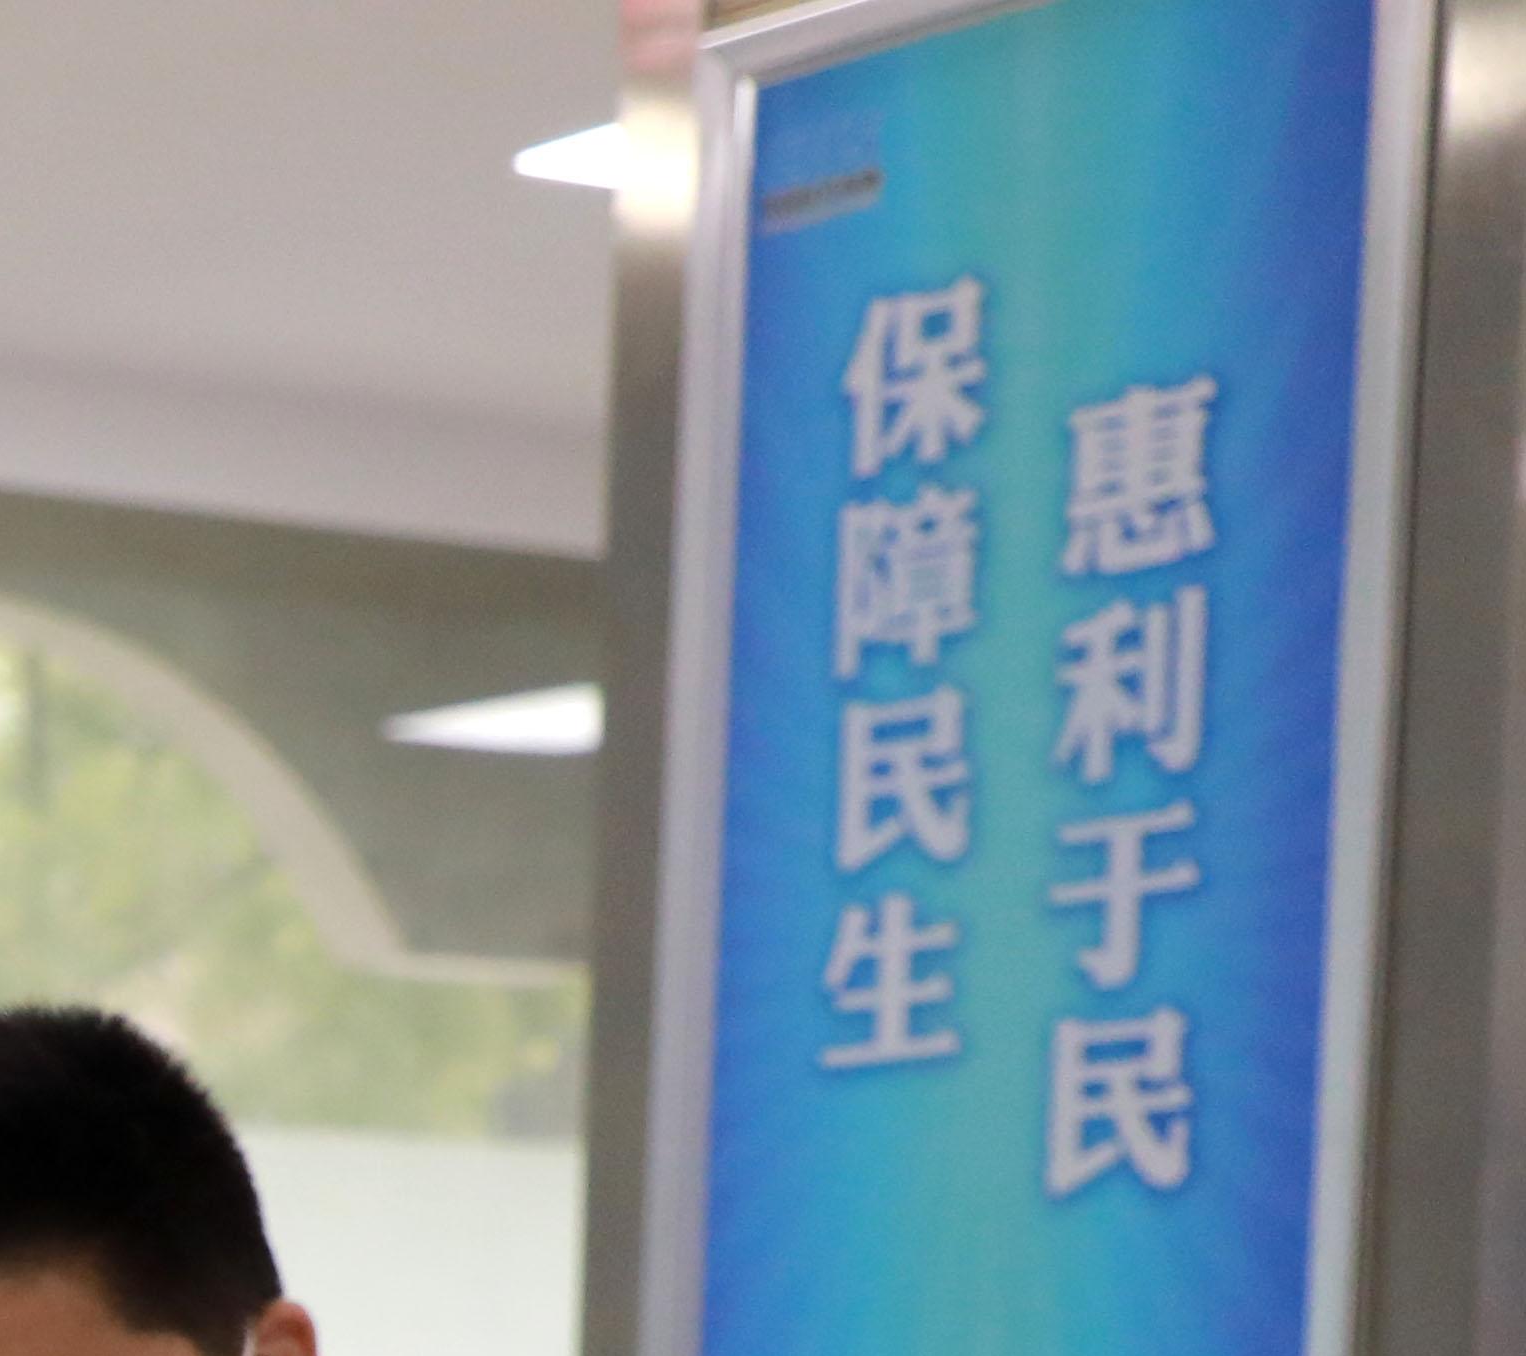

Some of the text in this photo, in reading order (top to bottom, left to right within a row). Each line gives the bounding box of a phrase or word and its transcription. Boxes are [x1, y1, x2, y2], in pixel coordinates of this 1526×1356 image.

[819, 274, 986, 1071] 保障民生
[1042, 375, 1218, 1197] 惠利于民
